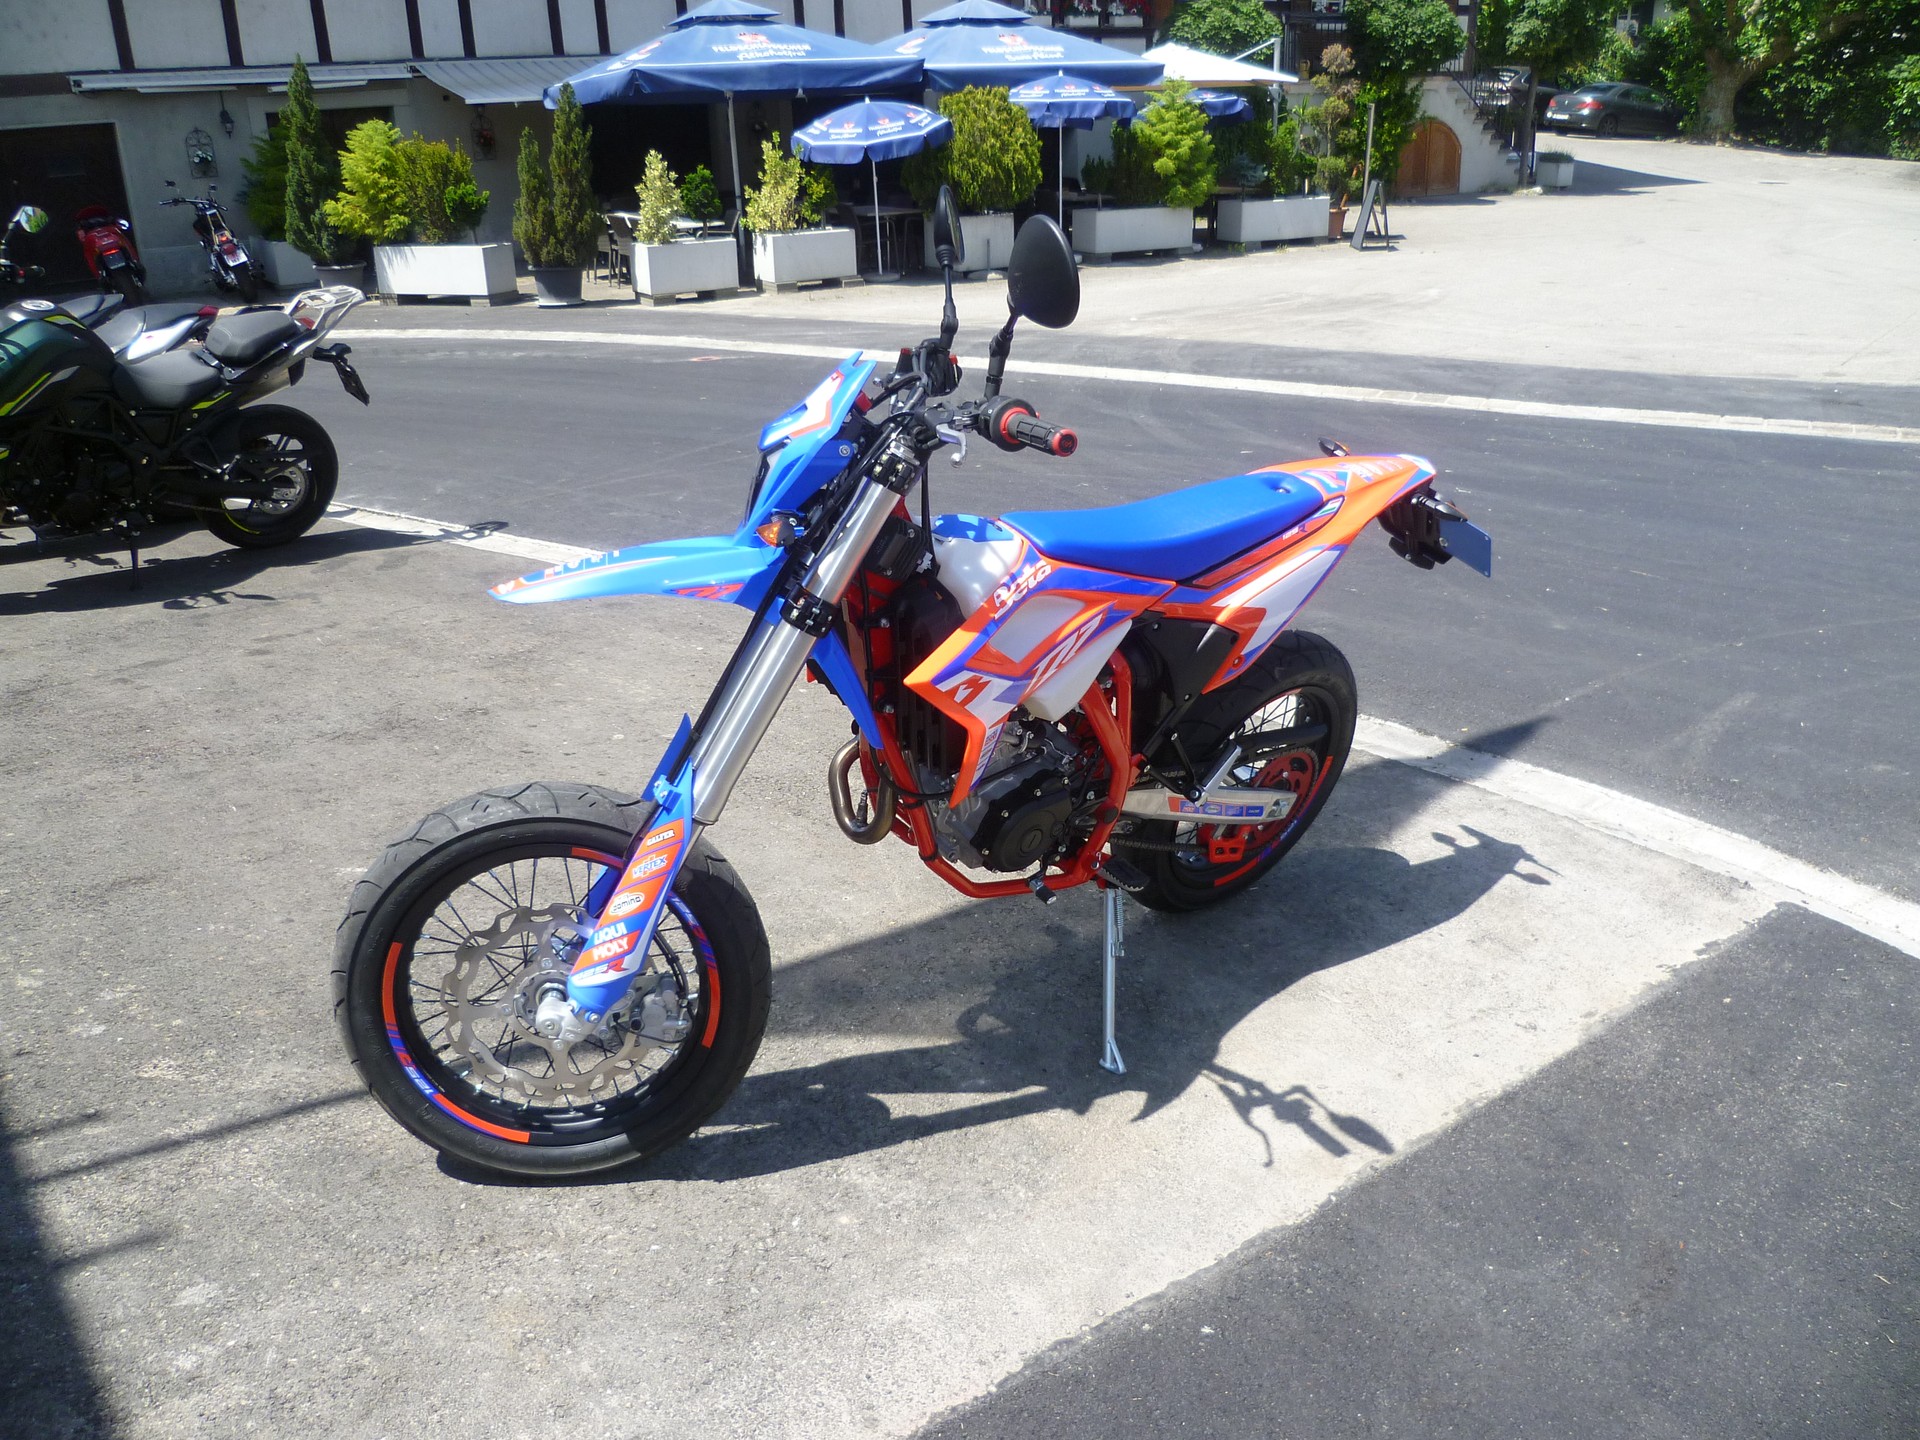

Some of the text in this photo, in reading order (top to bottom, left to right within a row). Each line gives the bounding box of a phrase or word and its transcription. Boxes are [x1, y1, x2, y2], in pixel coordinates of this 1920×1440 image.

[633, 855, 668, 876] VERTEX
[594, 921, 628, 946] LIQUI
[593, 937, 629, 961] MOLY
